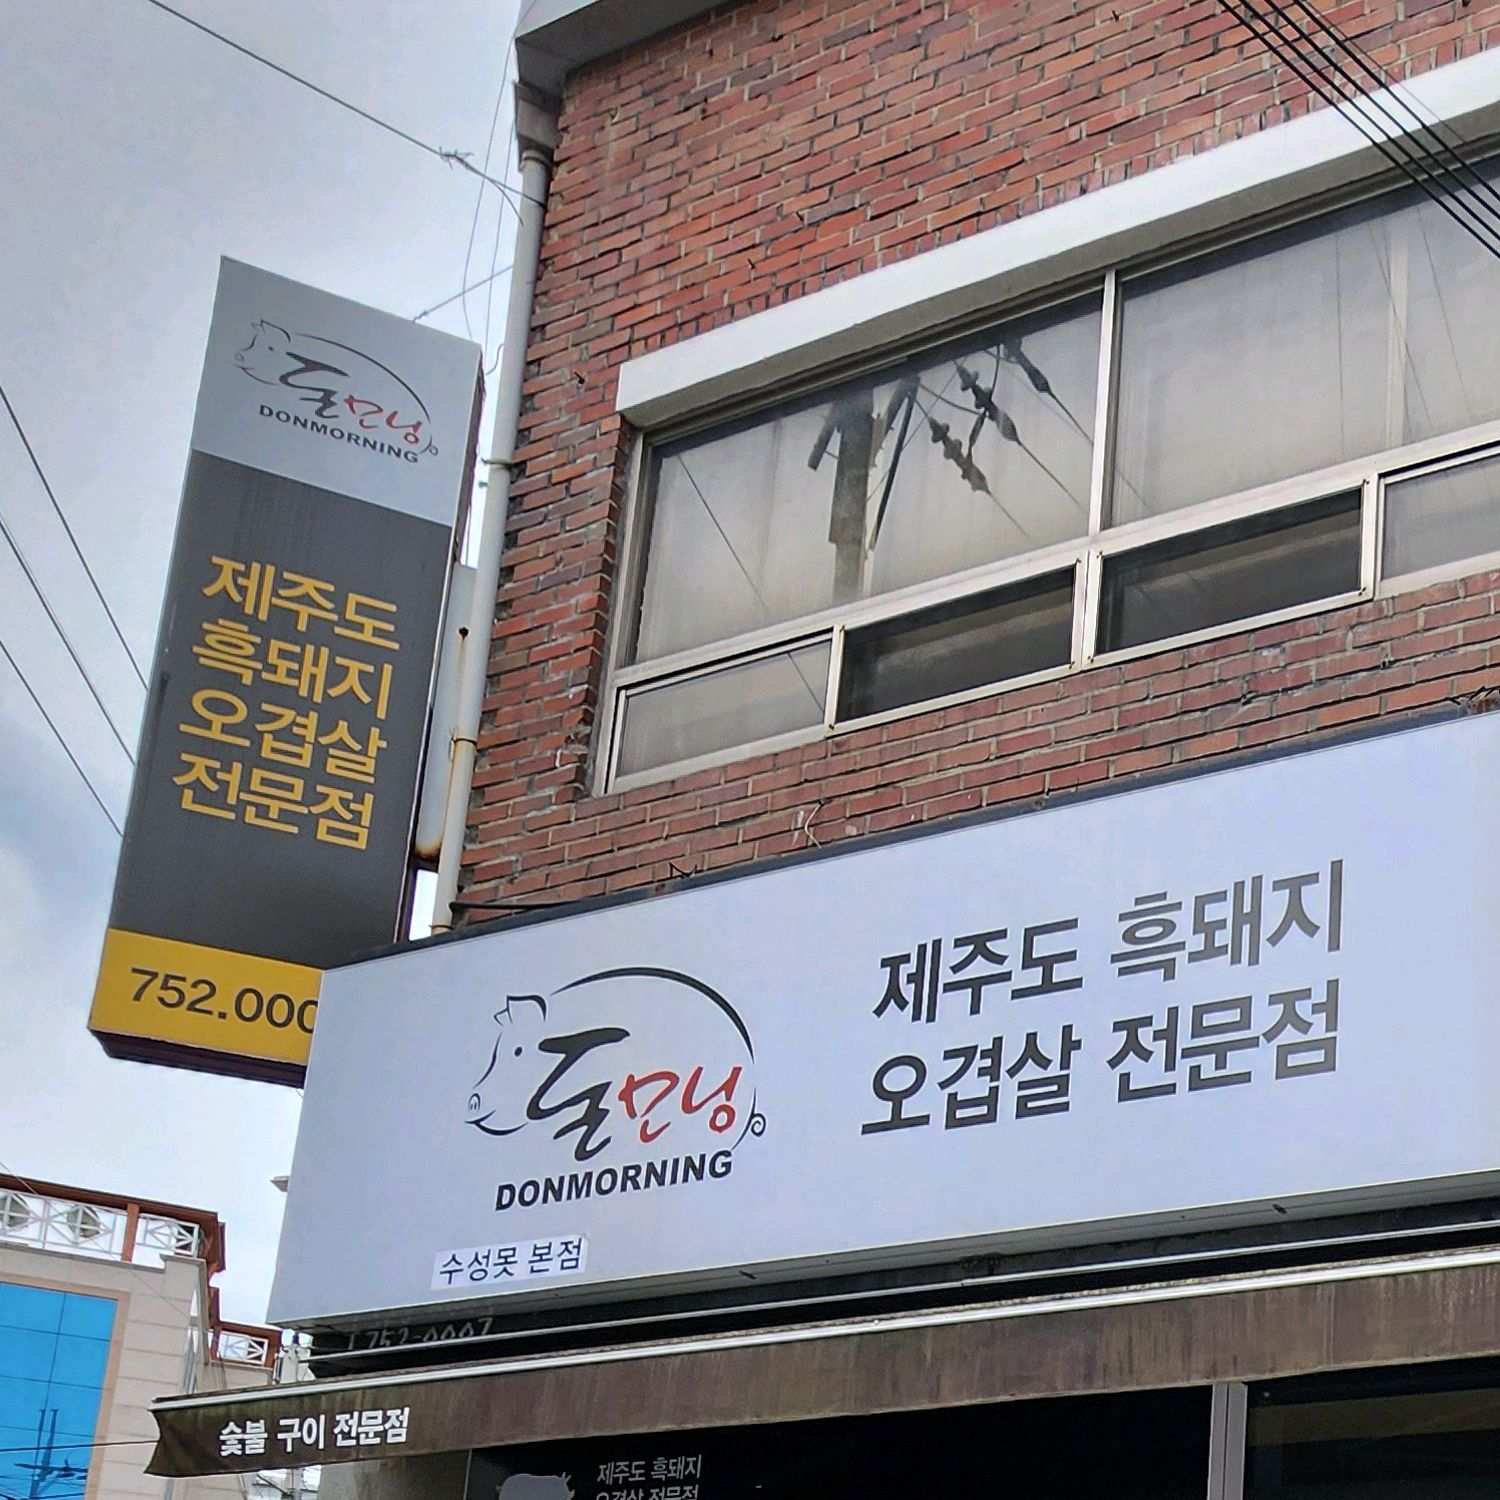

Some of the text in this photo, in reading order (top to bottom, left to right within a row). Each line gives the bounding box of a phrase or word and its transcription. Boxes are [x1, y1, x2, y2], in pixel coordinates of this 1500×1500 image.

[259, 404, 419, 464] DONMORNING
[201, 552, 400, 652] 제주도
[191, 617, 392, 720] 흑돼지
[178, 688, 387, 783] 오겹살
[173, 751, 375, 851] 전문점
[876, 861, 1344, 1023] 제주도 흑돼지
[861, 981, 1341, 1135] 오겹살 전문점
[494, 1150, 732, 1211] DONMORNING
[440, 1238, 583, 1285] 수성못 본점
[219, 1407, 410, 1457] 숯불 구이 전문점
[596, 1454, 703, 1485] 제주도 흑돼지
